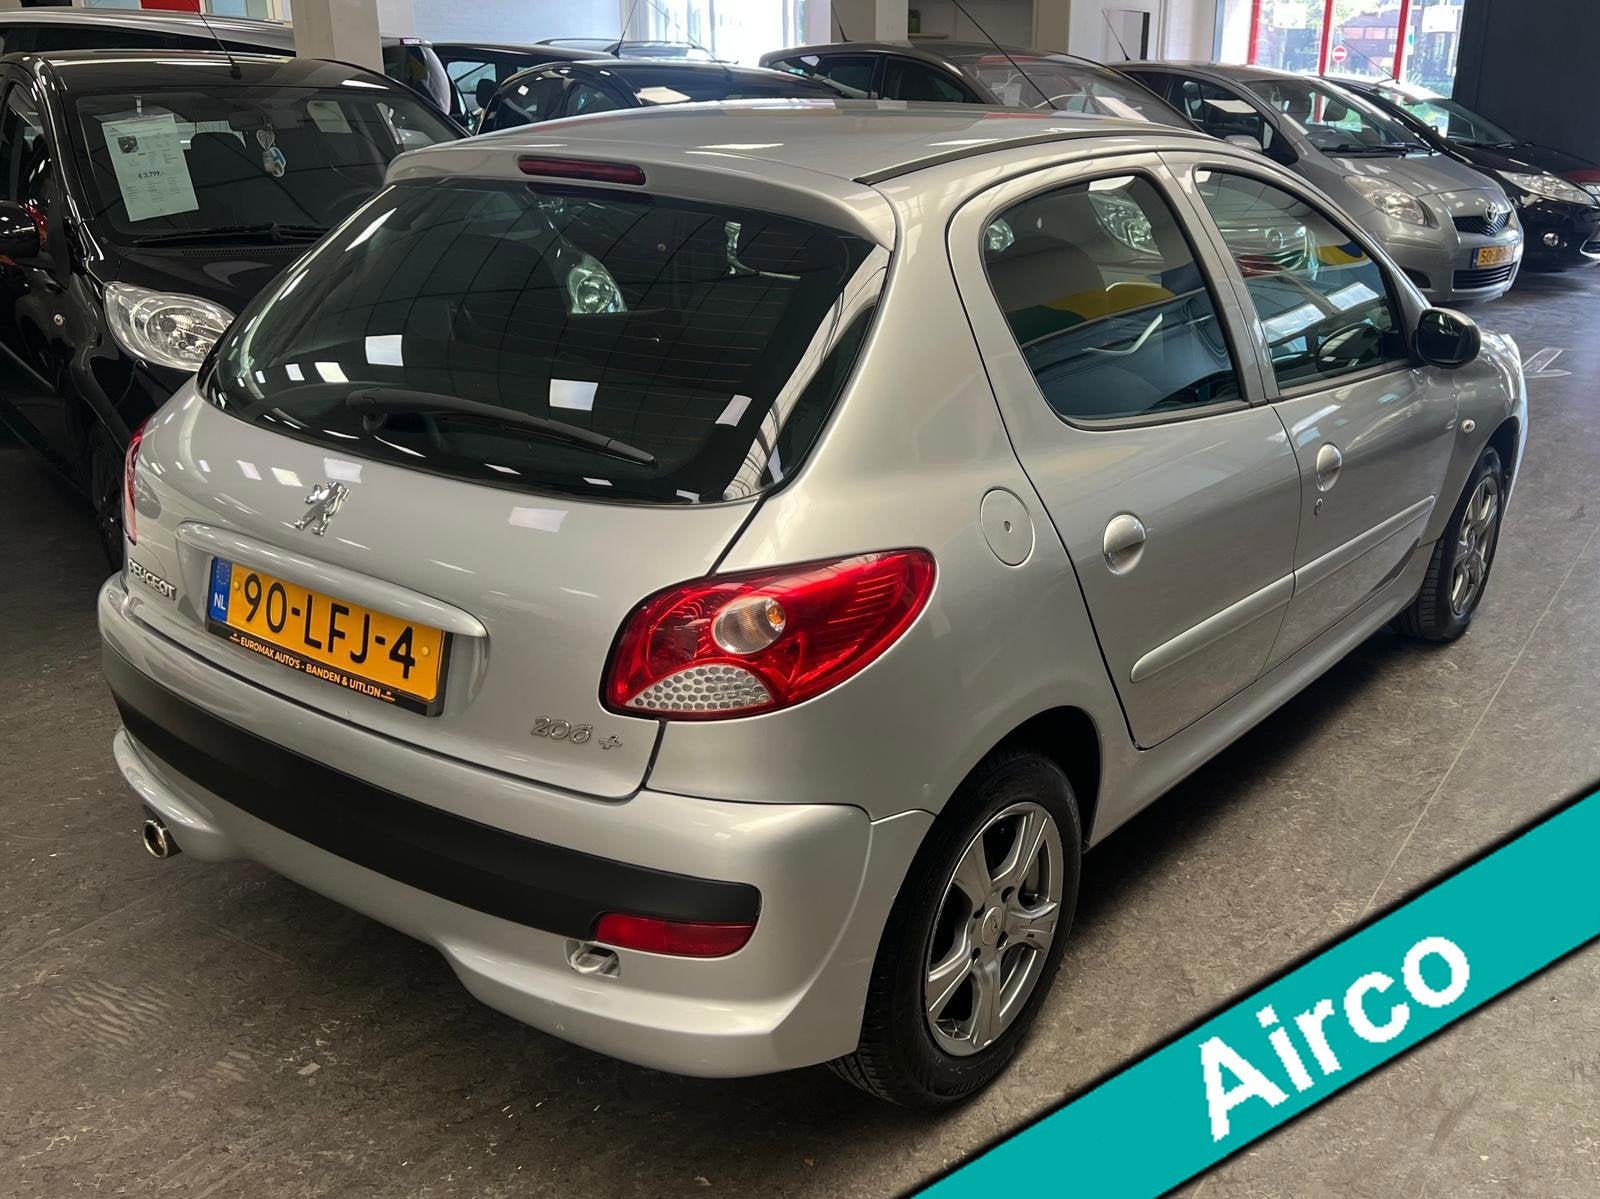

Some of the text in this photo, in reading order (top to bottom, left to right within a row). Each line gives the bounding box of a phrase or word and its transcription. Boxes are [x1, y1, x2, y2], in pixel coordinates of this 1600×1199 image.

[128, 557, 176, 600] PEUGEOT
[213, 592, 226, 611] NL
[244, 573, 416, 680] 90-LFJ-4
[240, 636, 274, 660] EUROMAX
[274, 651, 301, 670] AUTO'S
[305, 663, 341, 684] BANDEN
[342, 675, 348, 687] &
[349, 678, 382, 699] UITLIJN
[530, 716, 593, 744] 206
